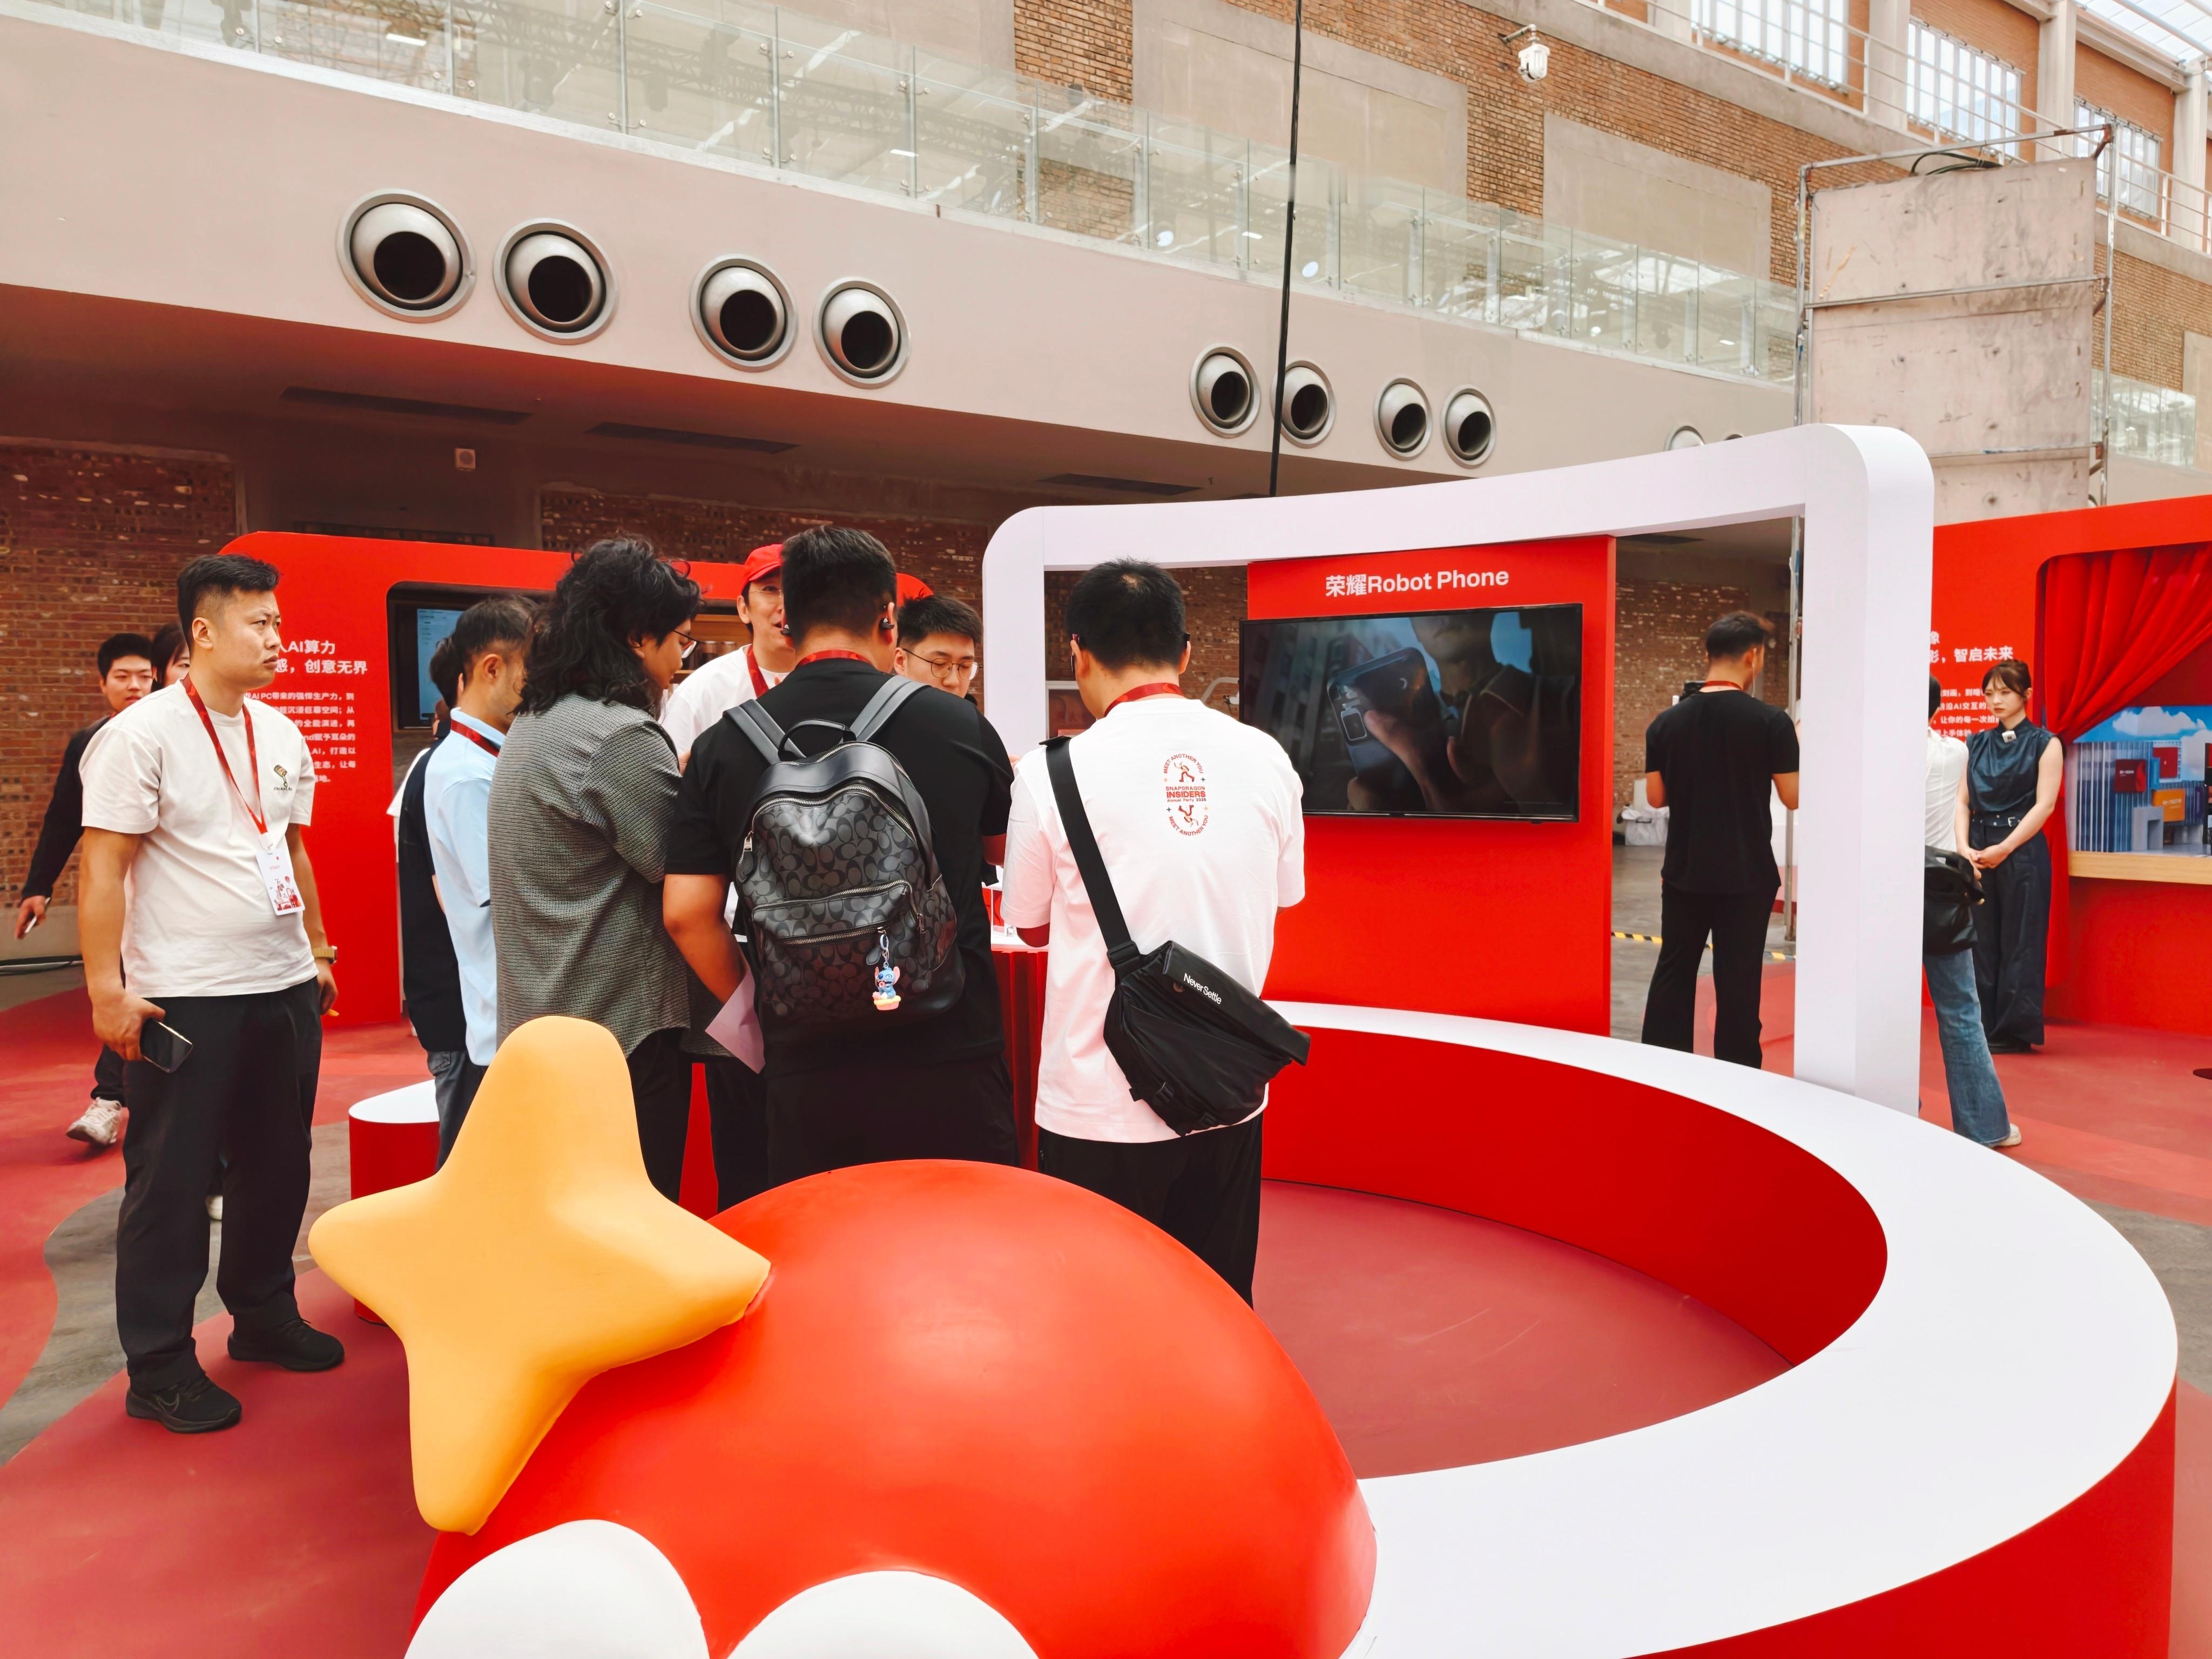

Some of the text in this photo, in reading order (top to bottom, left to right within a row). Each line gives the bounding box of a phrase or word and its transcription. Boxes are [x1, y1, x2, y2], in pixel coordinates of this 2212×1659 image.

[1325, 570, 1509, 597] 荣耀Robot Phone
[1163, 759, 1171, 774] MEET
[1171, 753, 1197, 763] ANOTHER
[1166, 791, 1206, 799] INSIDERS
[1169, 816, 1180, 831] MEET
[1179, 826, 1204, 836] ANOTHER
[1183, 973, 1222, 1004] Never Settle
